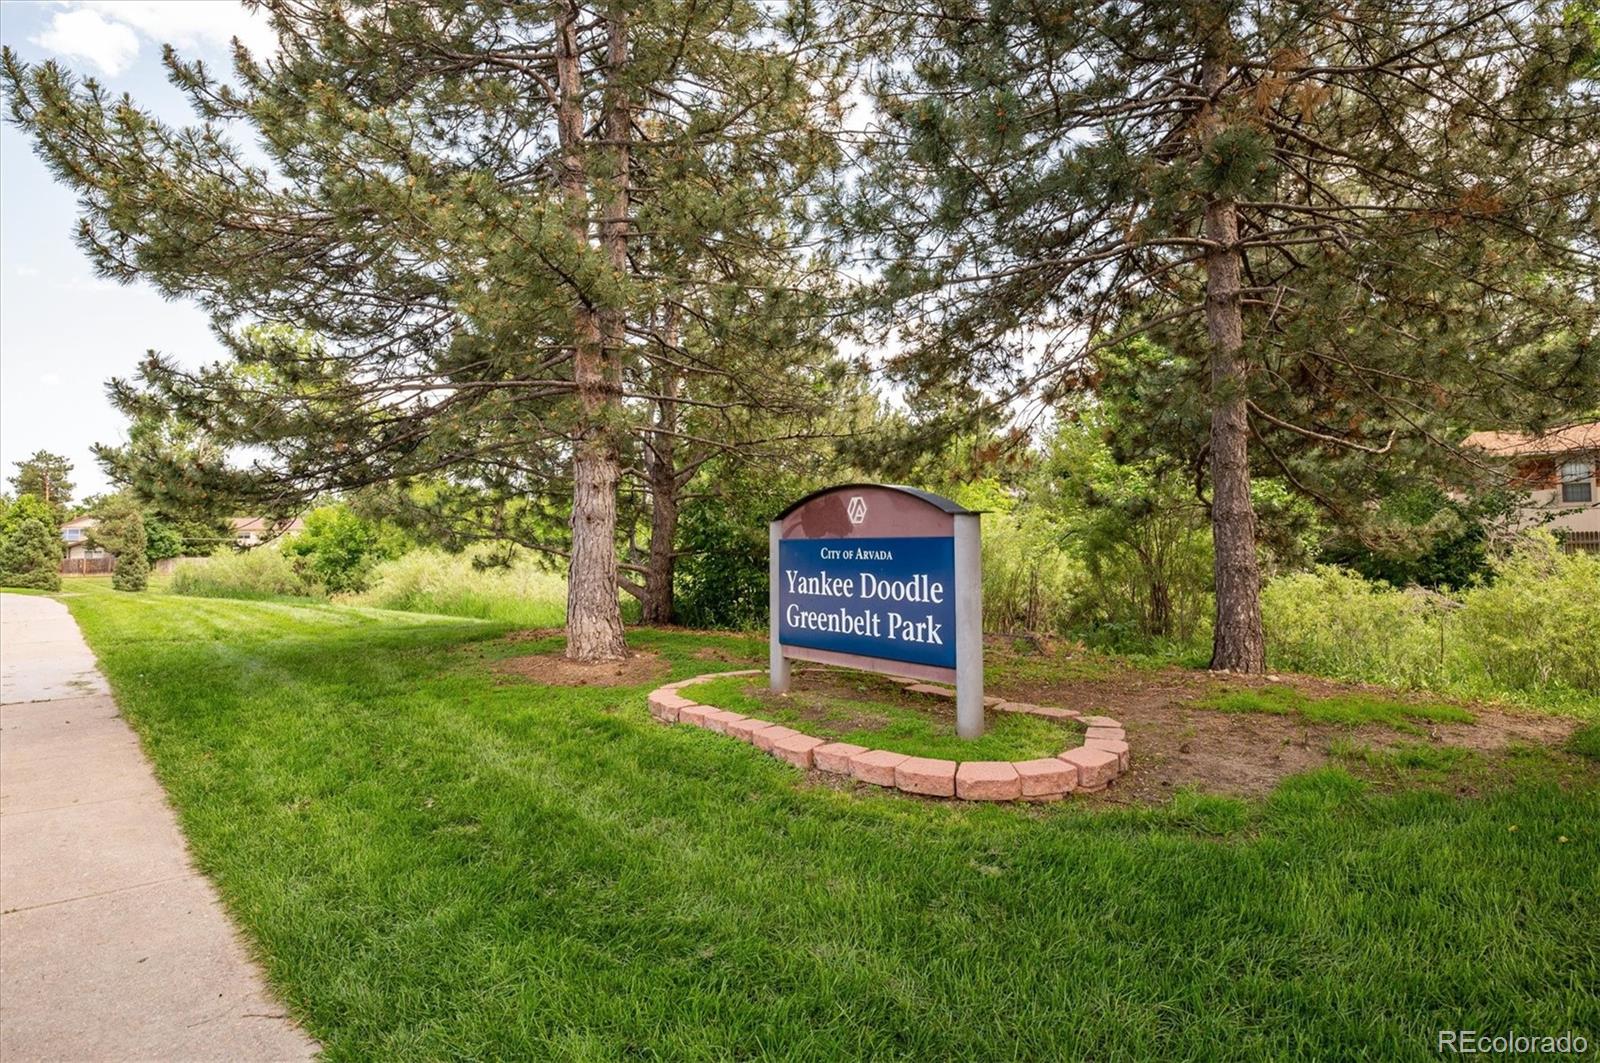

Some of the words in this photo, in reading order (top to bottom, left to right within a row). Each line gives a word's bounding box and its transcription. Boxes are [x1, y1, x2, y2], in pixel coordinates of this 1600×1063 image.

[786, 570, 854, 597] Yankee
[859, 573, 944, 603] Doodle
[786, 603, 881, 637] Greenbelt
[888, 612, 943, 645] Park
